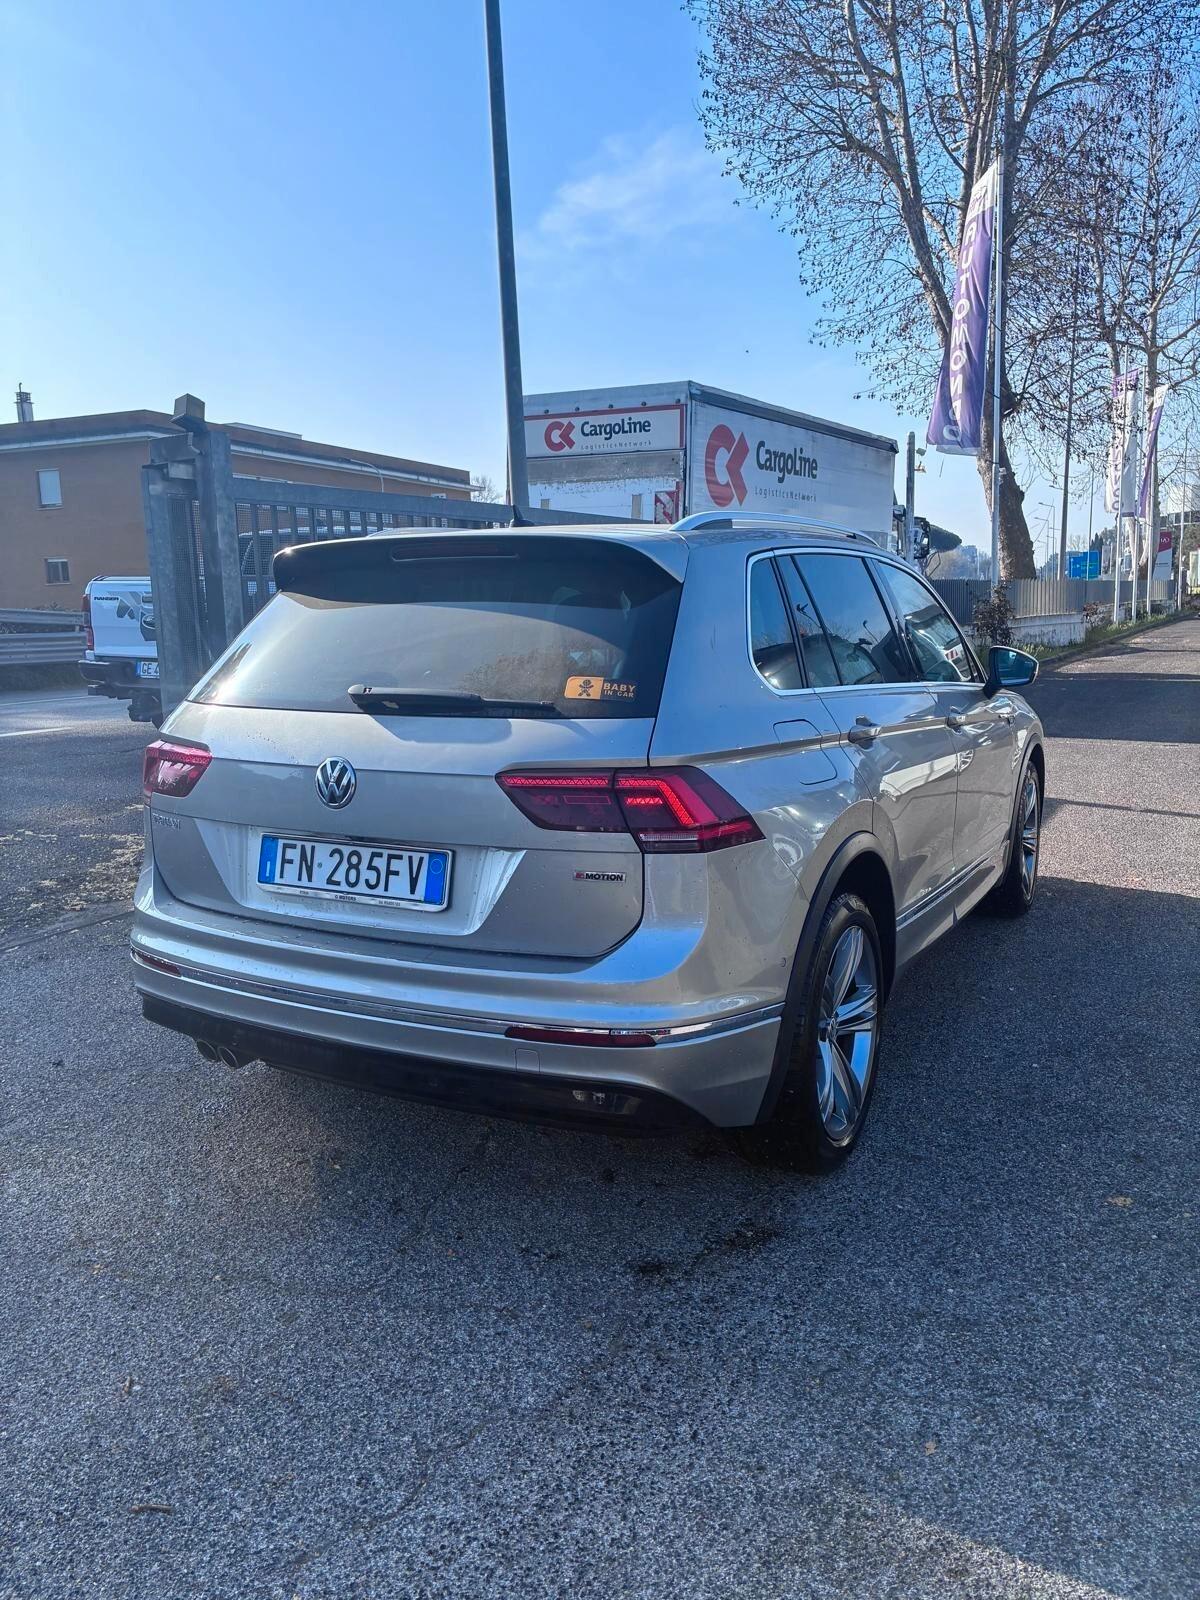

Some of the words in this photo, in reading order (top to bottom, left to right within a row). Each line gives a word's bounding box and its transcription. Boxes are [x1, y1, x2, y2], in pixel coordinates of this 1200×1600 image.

[580, 417, 652, 441] CargoLine
[756, 440, 818, 484] CargoLine
[142, 662, 152, 674] GE
[604, 683, 636, 693] BABY
[279, 843, 316, 883] FN
[326, 848, 424, 895] 285FV
